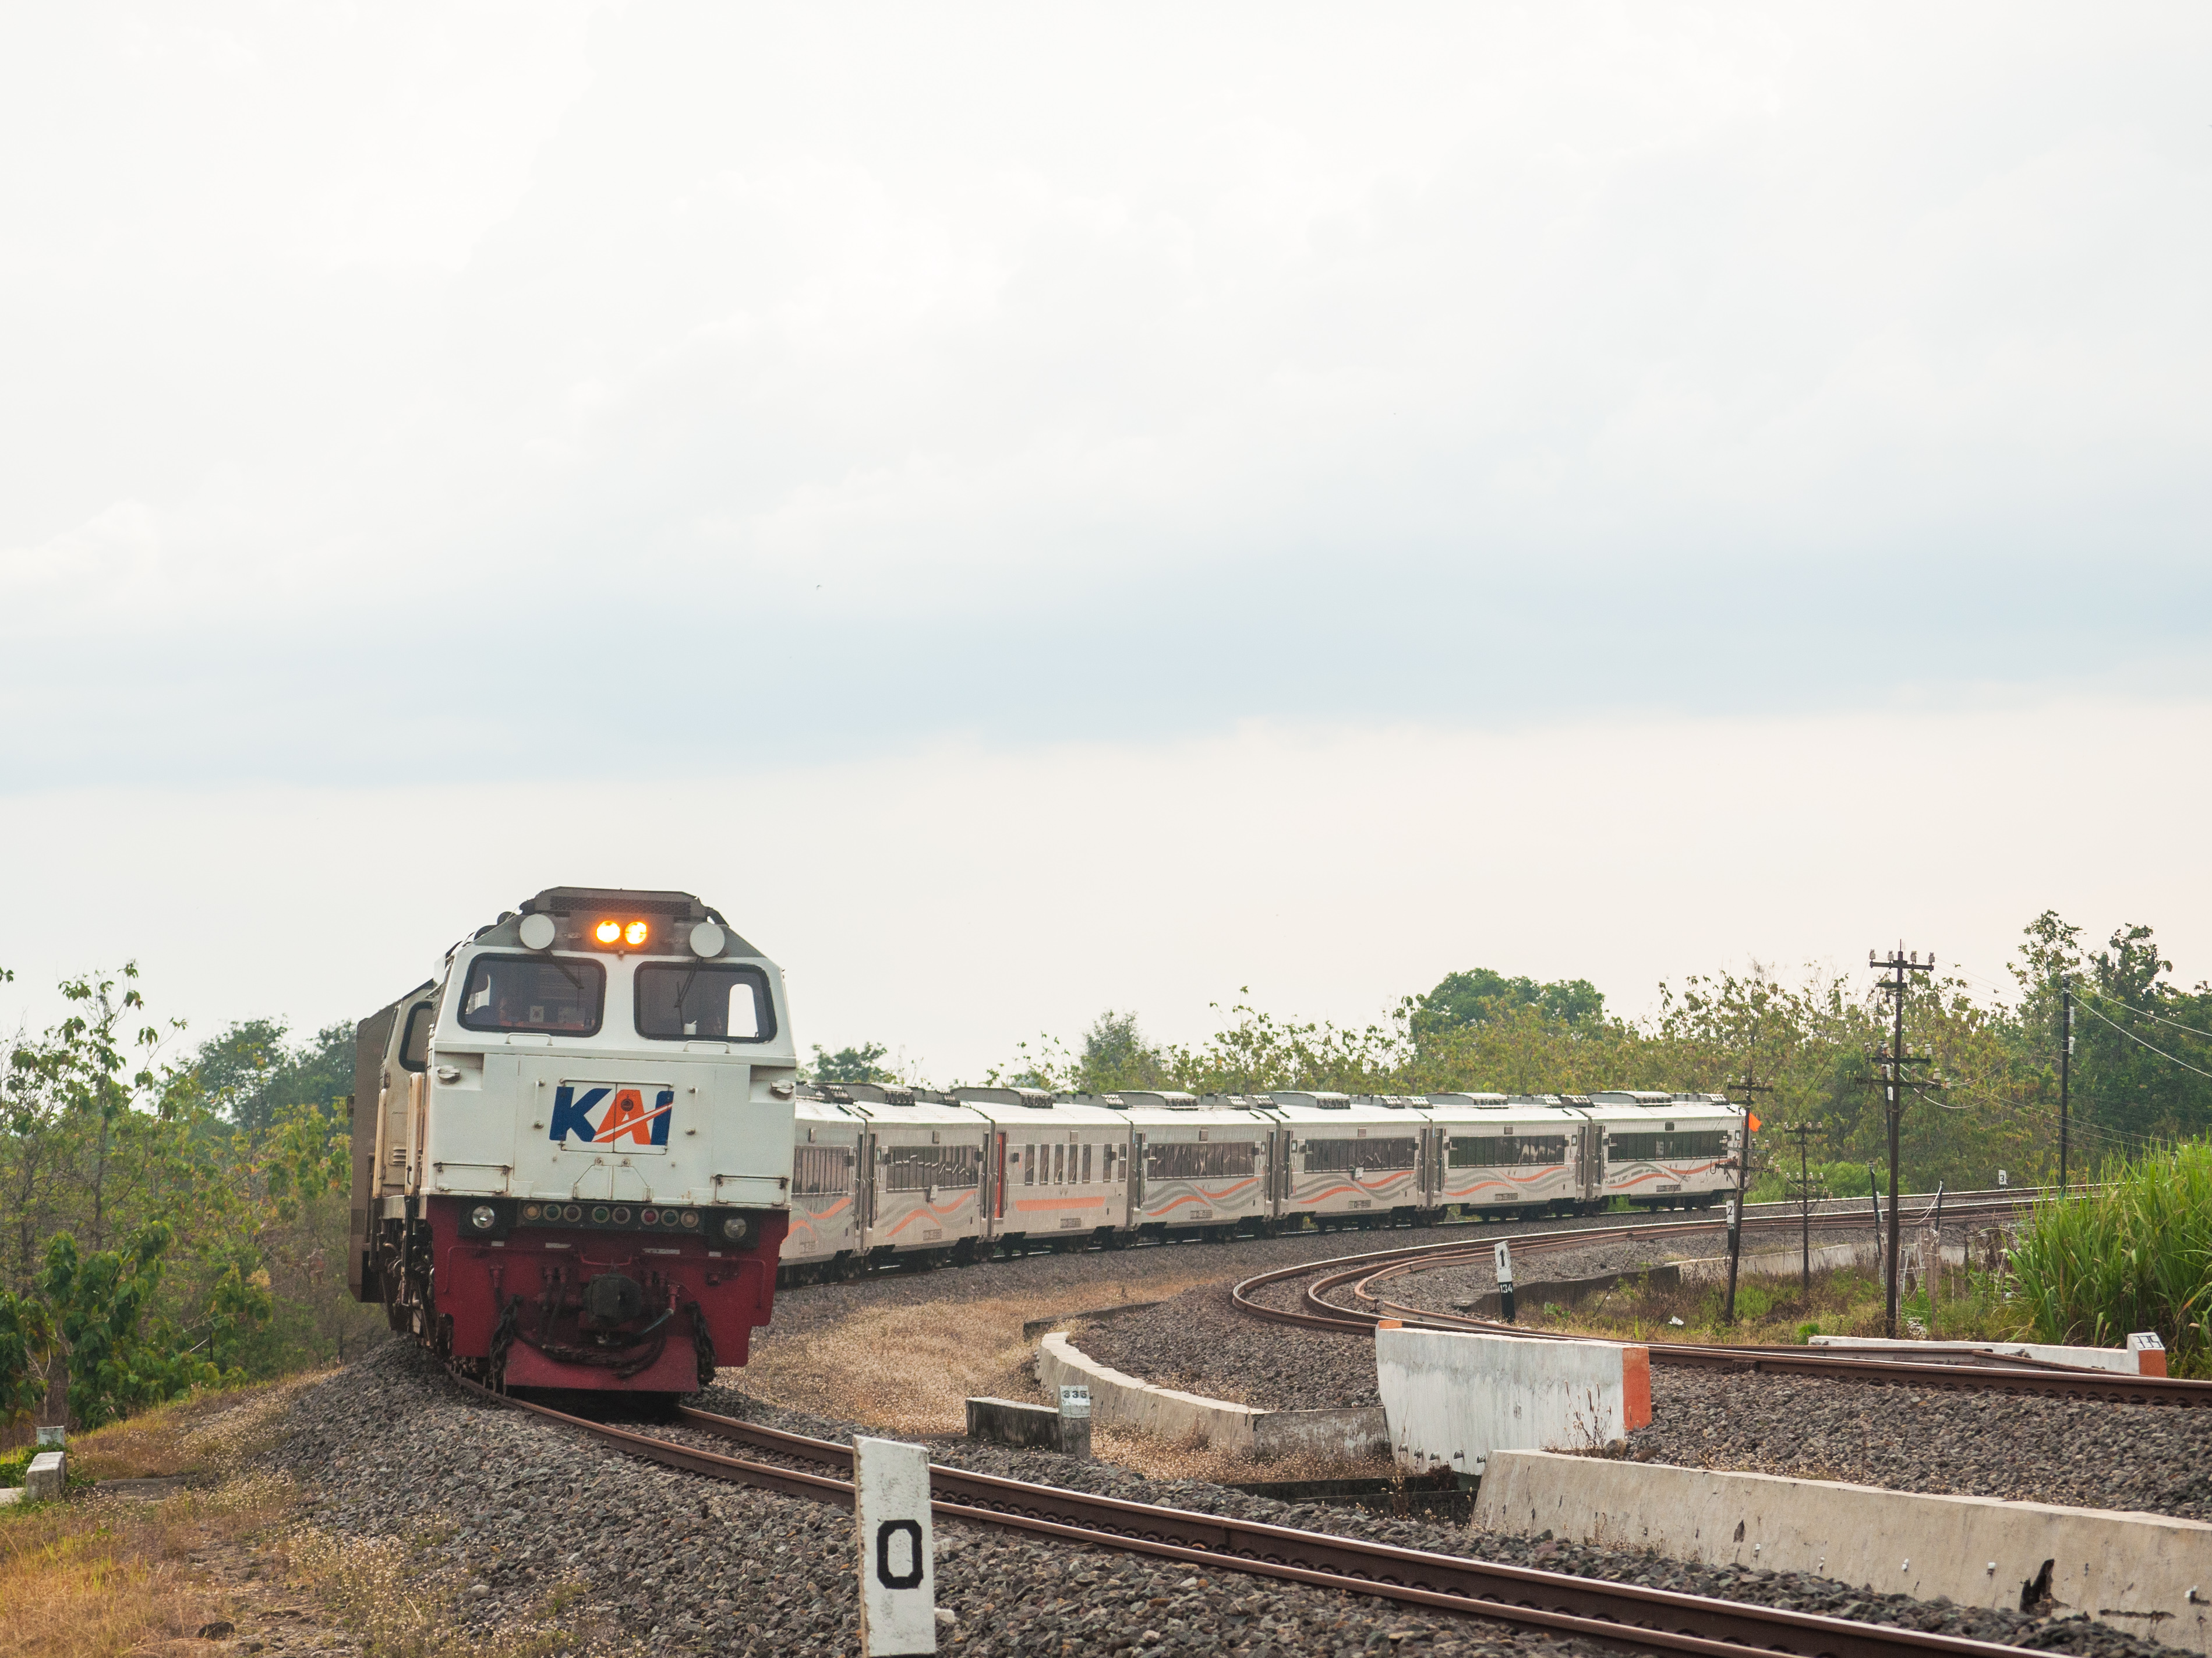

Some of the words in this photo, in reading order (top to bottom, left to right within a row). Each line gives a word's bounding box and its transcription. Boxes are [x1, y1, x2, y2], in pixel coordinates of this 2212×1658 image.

[549, 1086, 674, 1146] KAI
[1727, 1206, 1733, 1215] 2
[1500, 1249, 1505, 1267] 1
[1500, 1284, 1513, 1293] 134
[2133, 1335, 2162, 1349] 335
[1063, 1390, 1087, 1398] 335
[877, 1519, 924, 1589] 0
